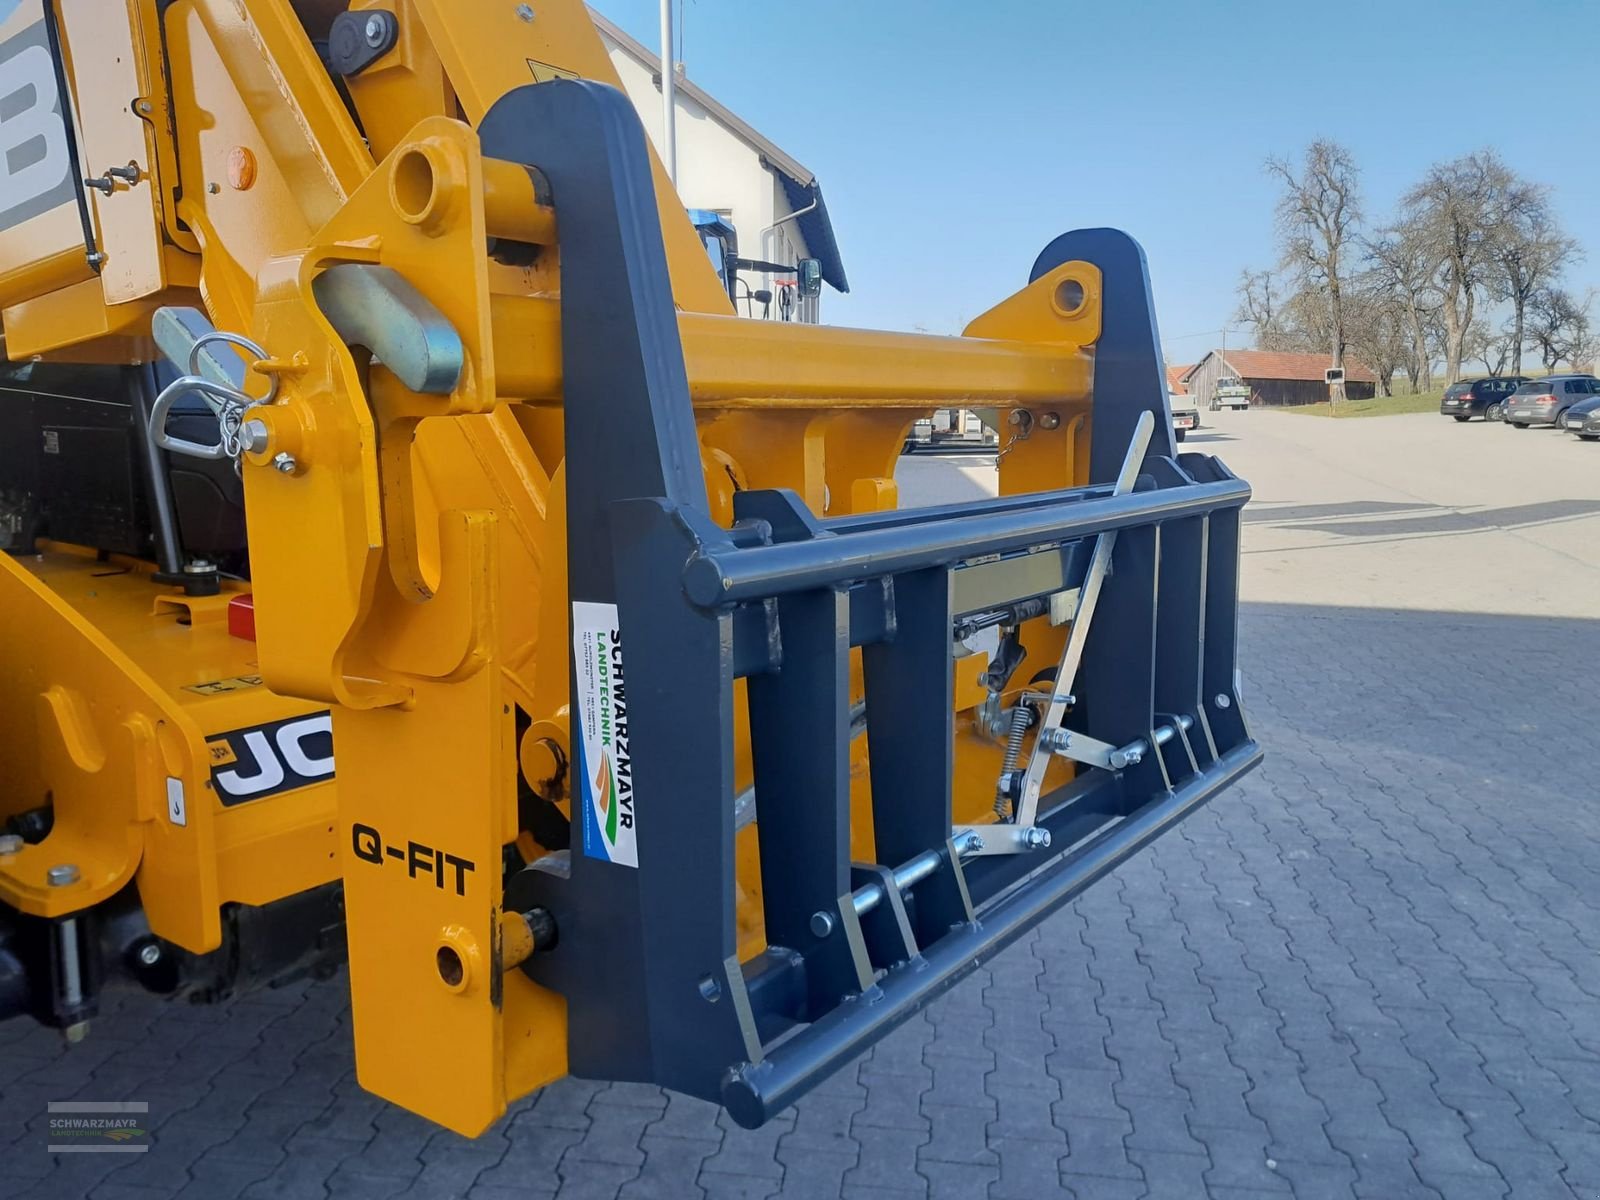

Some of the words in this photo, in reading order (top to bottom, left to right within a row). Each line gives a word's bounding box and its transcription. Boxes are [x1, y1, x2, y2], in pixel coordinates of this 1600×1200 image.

[597, 632, 611, 746] LANDTECHNIK
[610, 629, 633, 829] SCHWARZMAYR
[352, 823, 475, 896] Q-FIT
